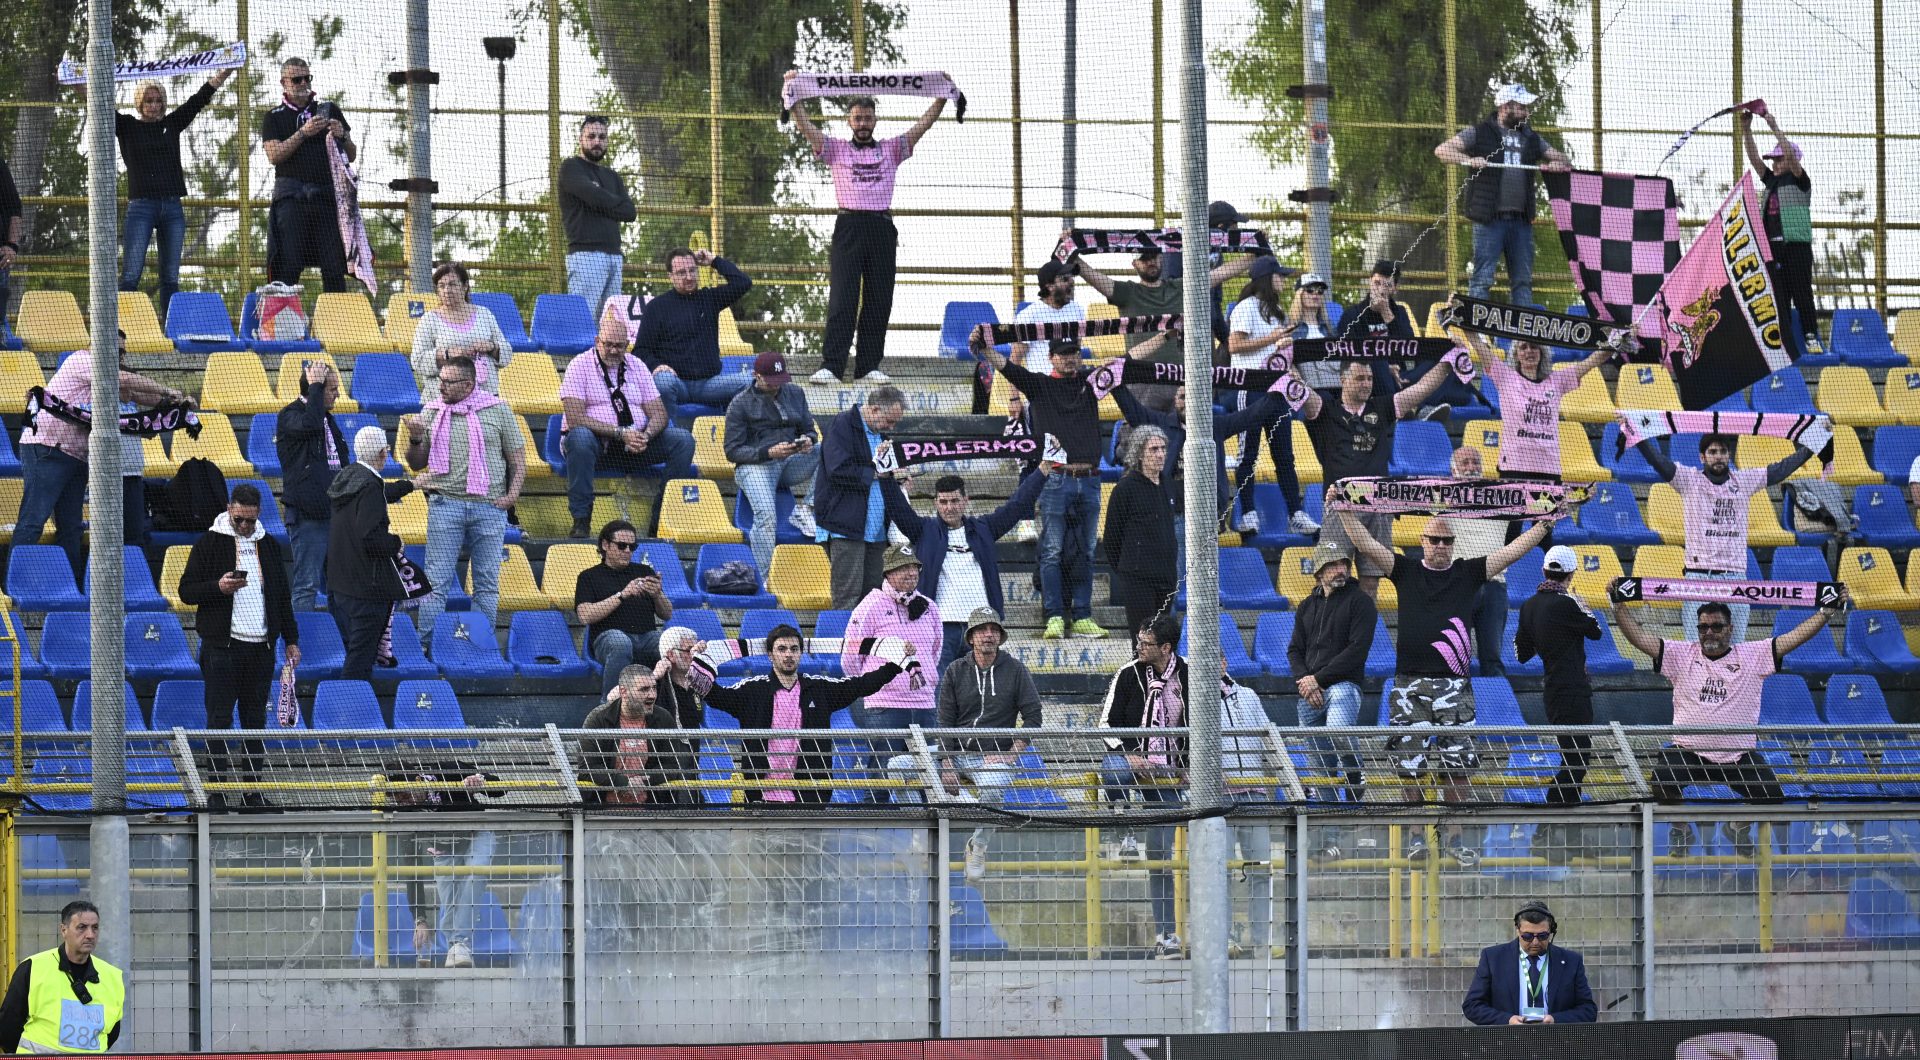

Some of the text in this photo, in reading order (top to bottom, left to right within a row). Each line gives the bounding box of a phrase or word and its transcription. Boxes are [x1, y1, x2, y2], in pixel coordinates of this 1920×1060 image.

[817, 75, 924, 89] PALERMO FC
[1472, 303, 1592, 345] PALERMO
[1325, 340, 1419, 358] PALERMO
[1154, 362, 1247, 386] PALMO
[901, 439, 1037, 461] PALERMO
[1375, 481, 1525, 506] FORZA PALERMO
[1701, 685, 1727, 696] WILD
[1705, 676, 1724, 687] OLD
[1699, 693, 1728, 703] WEST
[60, 1023, 101, 1048] 288
